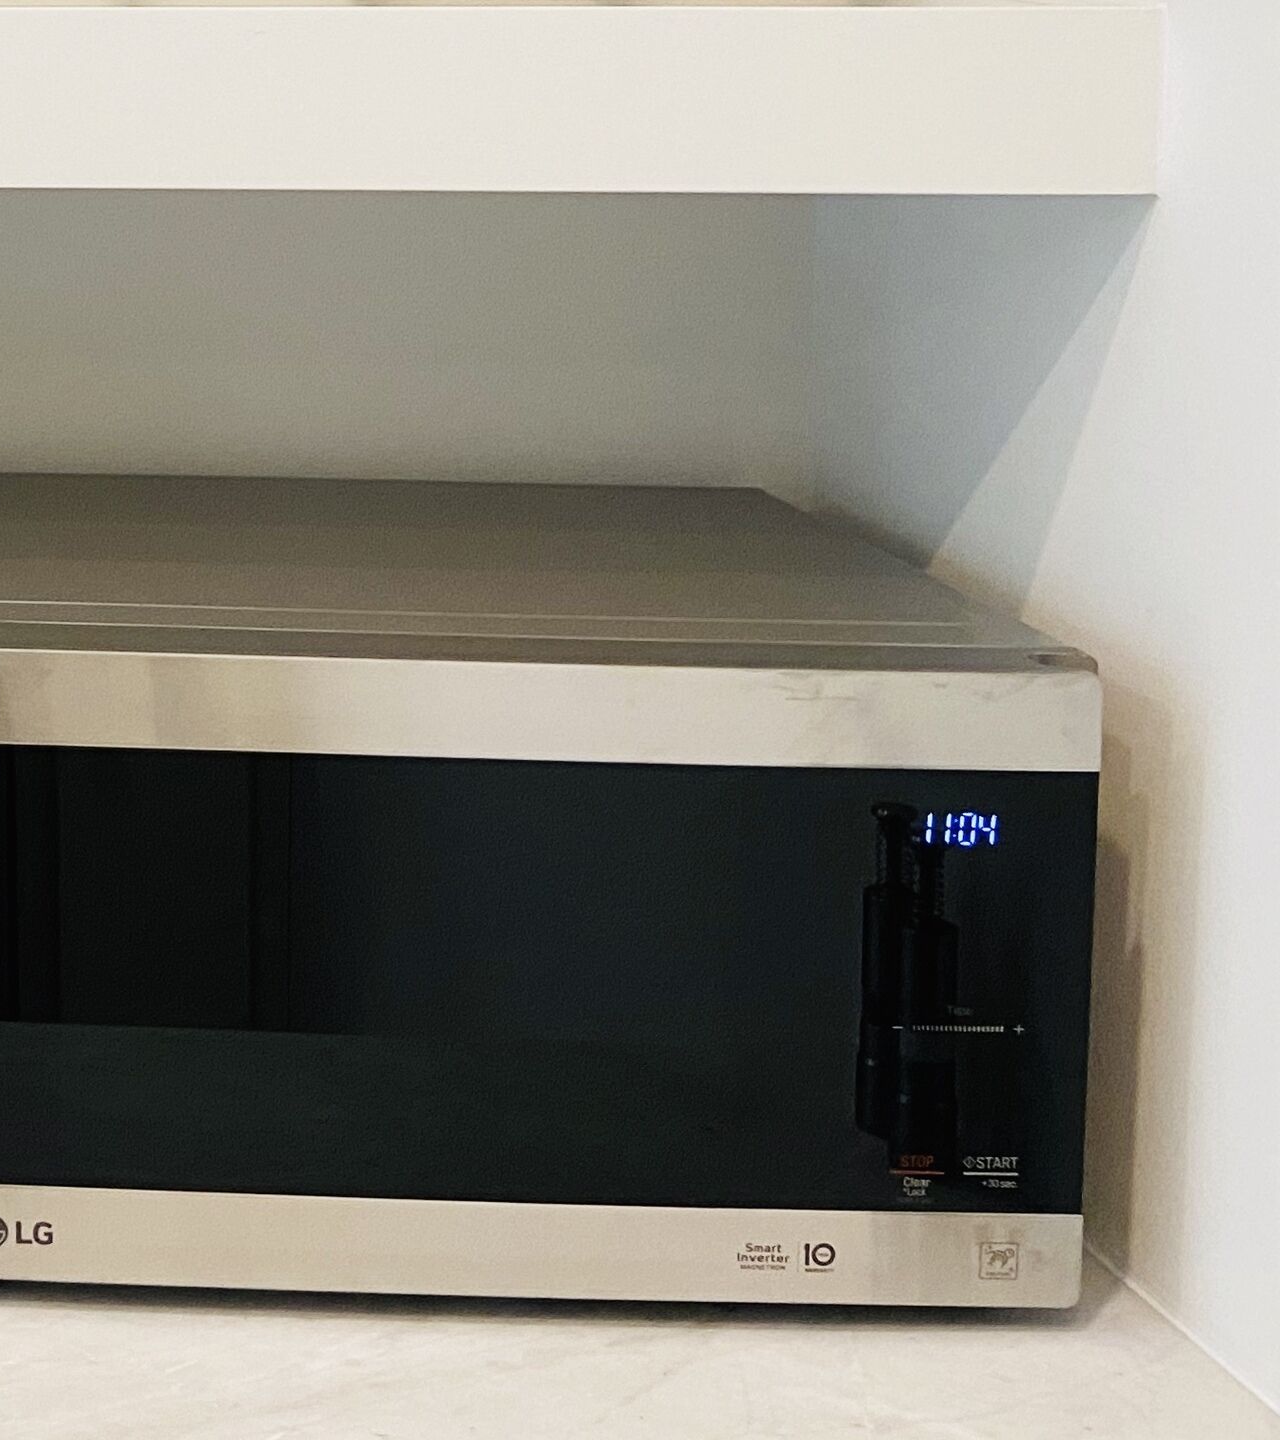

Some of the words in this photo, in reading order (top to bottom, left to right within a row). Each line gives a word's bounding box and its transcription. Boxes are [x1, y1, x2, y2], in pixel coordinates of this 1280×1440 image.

[926, 812, 997, 845] 11:04
[902, 1155, 934, 1167] STOP
[976, 1157, 1018, 1169] START
[15, 1222, 53, 1245] LG
[745, 1243, 781, 1252] Smart
[737, 1253, 790, 1262] Inverter
